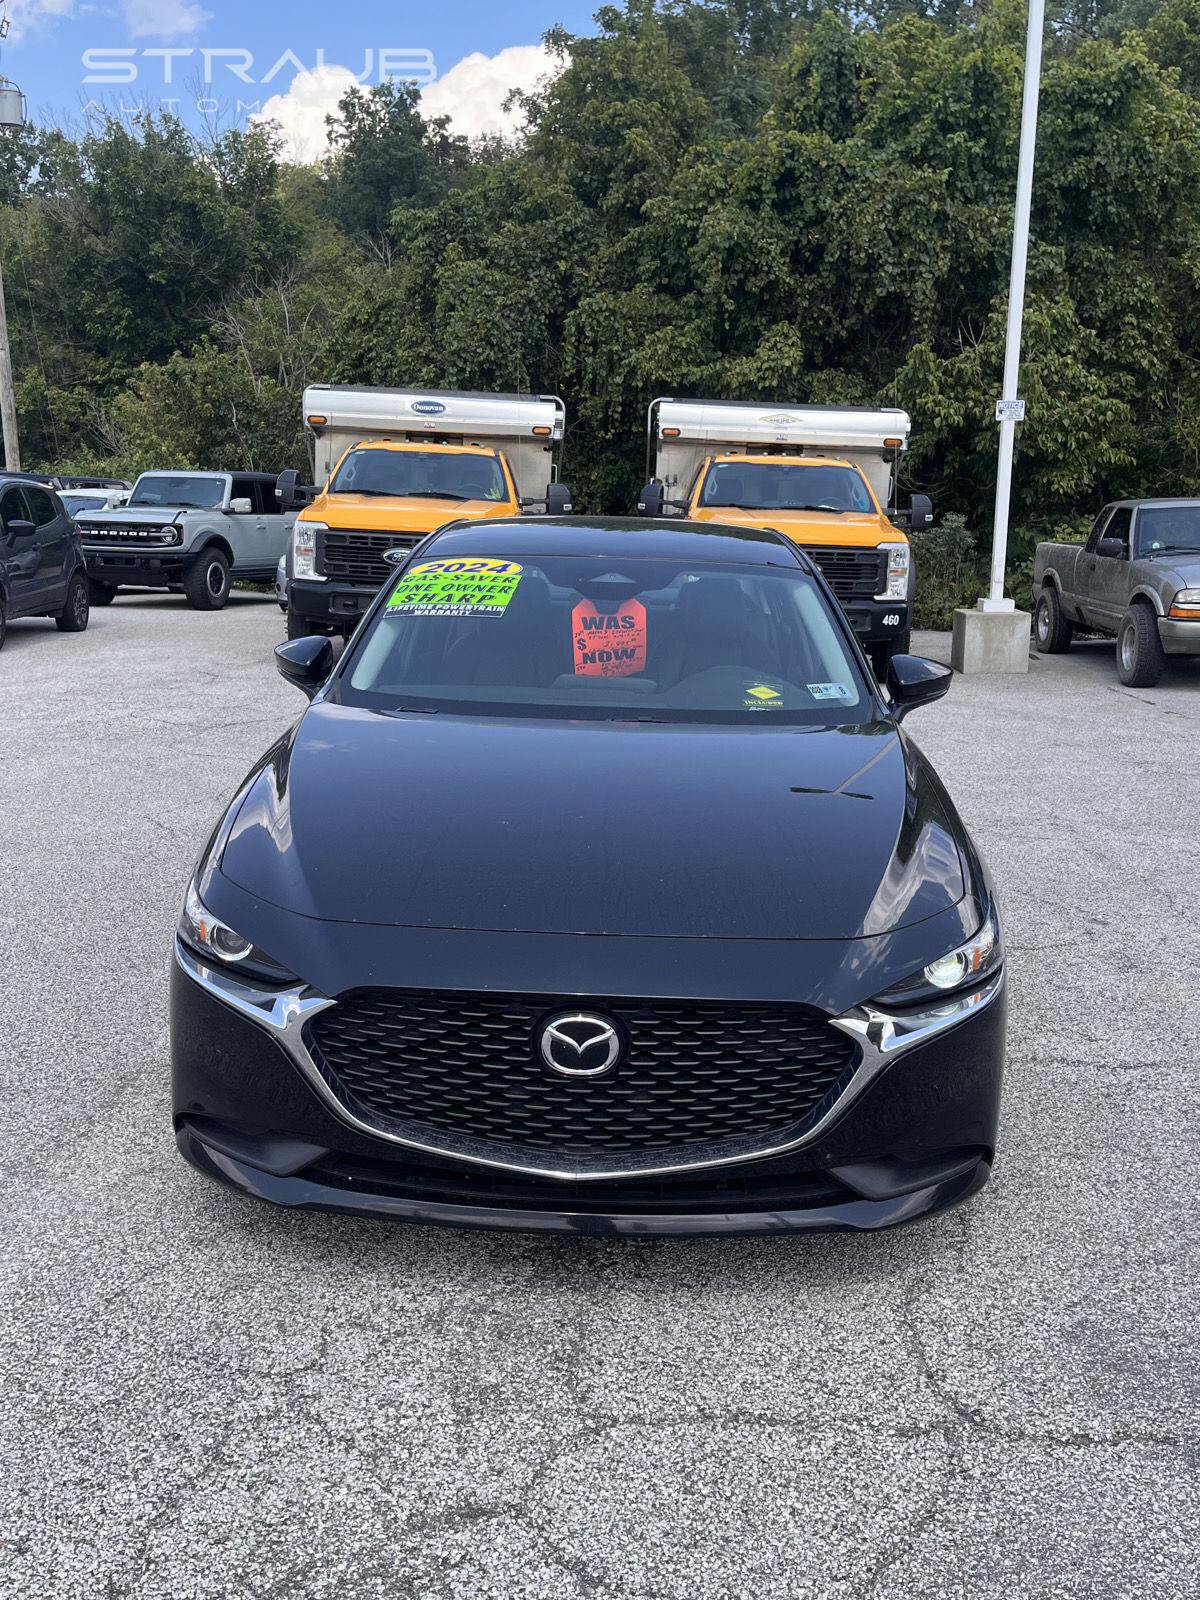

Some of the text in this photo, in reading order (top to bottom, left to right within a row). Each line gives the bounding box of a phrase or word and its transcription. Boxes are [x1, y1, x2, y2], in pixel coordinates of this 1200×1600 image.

[413, 403, 444, 411] Donovan
[421, 562, 511, 574] 2024
[403, 574, 515, 584] GAS-SAVER
[397, 584, 514, 595] ONE OWNER
[401, 593, 494, 604] SHARP
[388, 604, 505, 612] LIFETIME POWERTRAIN
[581, 616, 635, 630] WAS
[882, 614, 900, 626] 460
[577, 638, 587, 651] $
[582, 648, 636, 664] NOW
